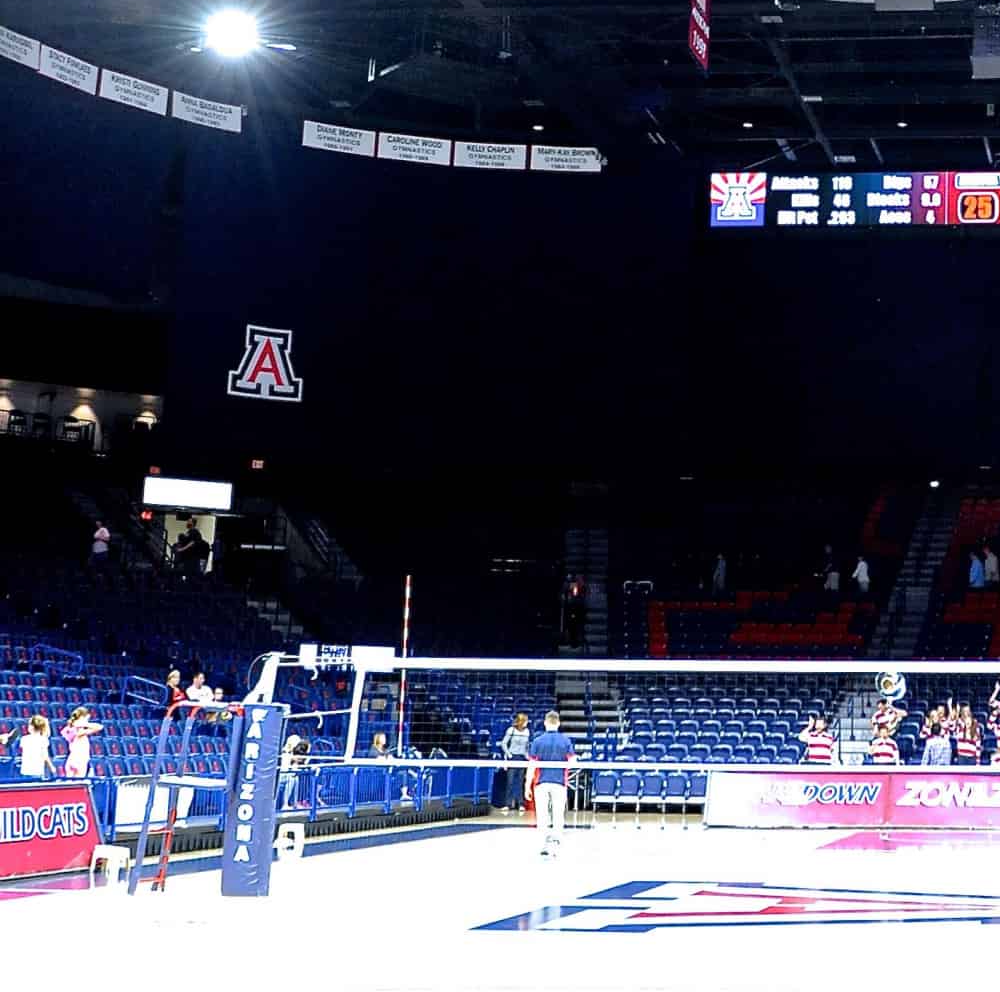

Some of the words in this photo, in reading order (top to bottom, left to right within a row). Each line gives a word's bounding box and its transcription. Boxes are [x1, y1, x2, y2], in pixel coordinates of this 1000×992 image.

[963, 196, 993, 219] 25
[233, 723, 267, 864] ARIZONA
[0, 802, 89, 843] ILDCATS
